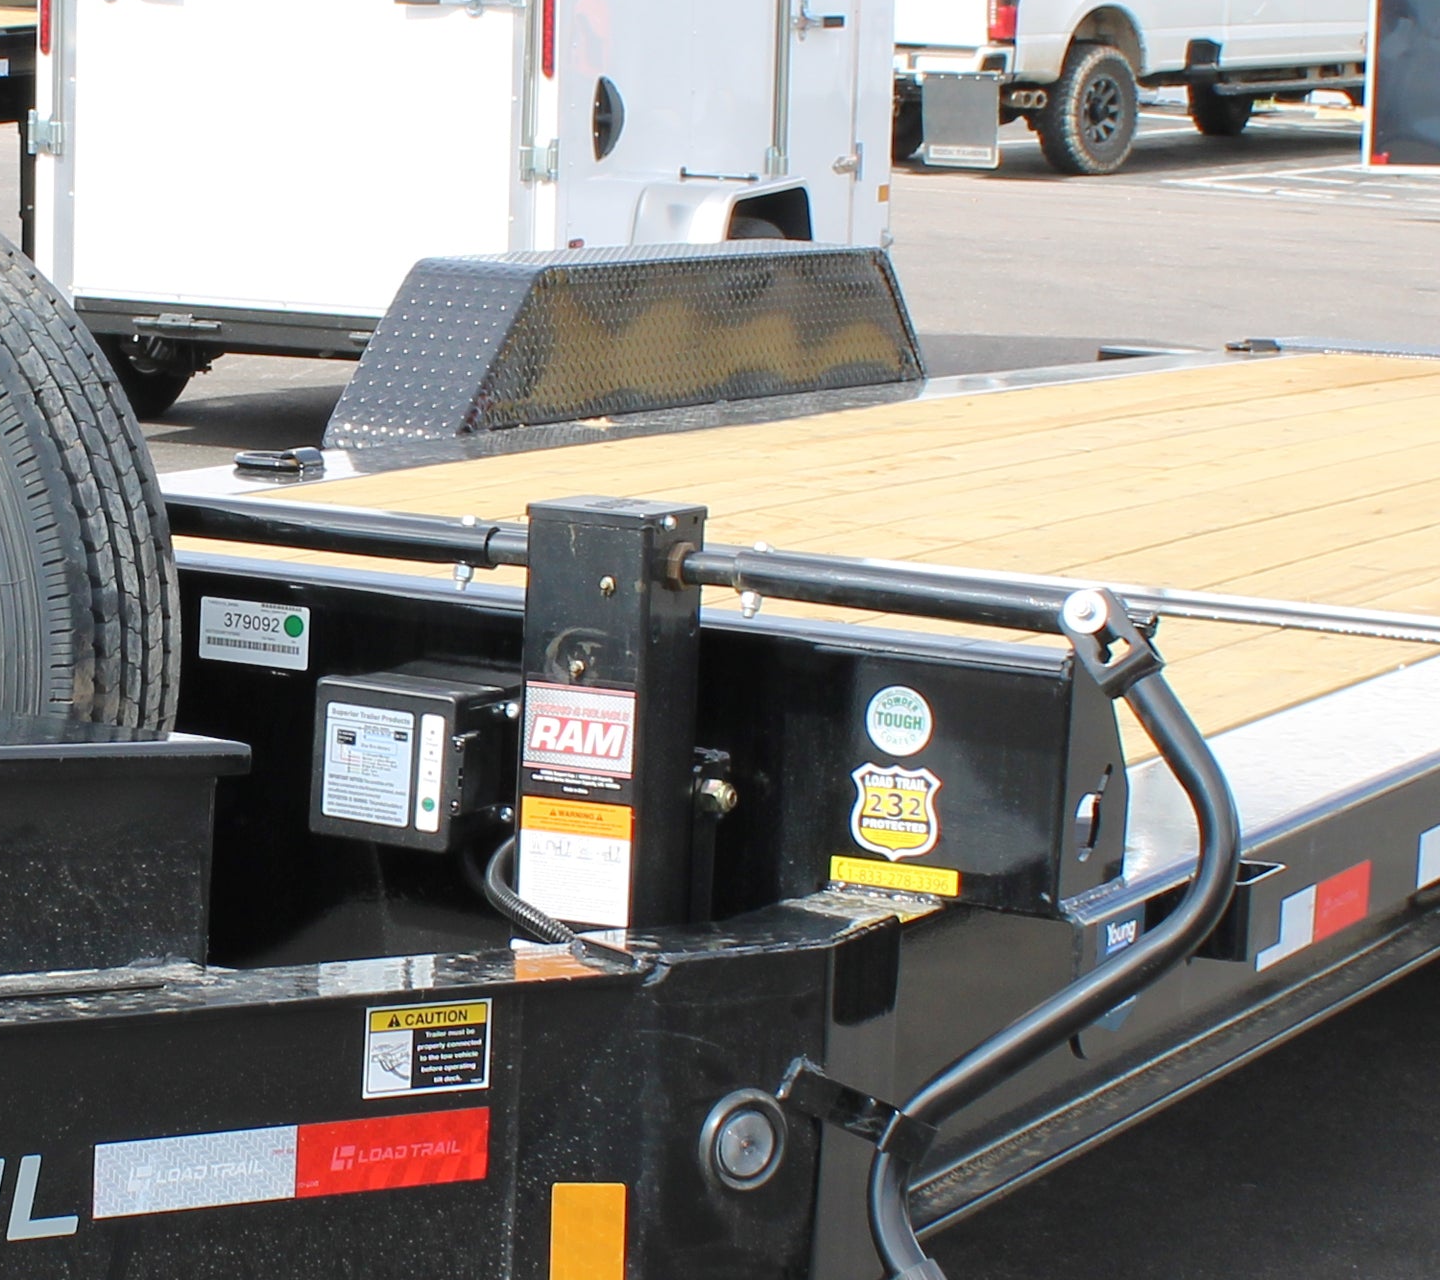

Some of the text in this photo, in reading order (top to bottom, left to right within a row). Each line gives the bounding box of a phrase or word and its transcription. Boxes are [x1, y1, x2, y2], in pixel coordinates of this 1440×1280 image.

[223, 612, 280, 633] 379092
[881, 696, 920, 712] POWDER
[360, 712, 381, 721] Trailer
[381, 714, 411, 726] Products
[875, 710, 923, 731] TOUGH
[529, 715, 626, 758] RAM
[880, 729, 918, 746] COATED
[864, 774, 928, 792] LOAD TRAIL
[870, 793, 921, 818] 232
[558, 810, 595, 821] WARNING
[862, 817, 928, 835] PROTECTED
[847, 868, 950, 893] 1-833-278-3396
[1107, 920, 1136, 946] Young
[405, 1010, 468, 1026] CAUTION
[447, 1029, 465, 1037] must
[417, 1038, 482, 1052] properly connected
[419, 1054, 427, 1062] to
[428, 1053, 439, 1061] the
[454, 1050, 479, 1059] vehicle
[421, 1062, 476, 1074] before operating
[358, 1140, 462, 1164] LOAD TRAIL
[155, 1160, 264, 1185] LOAD TRAIL
